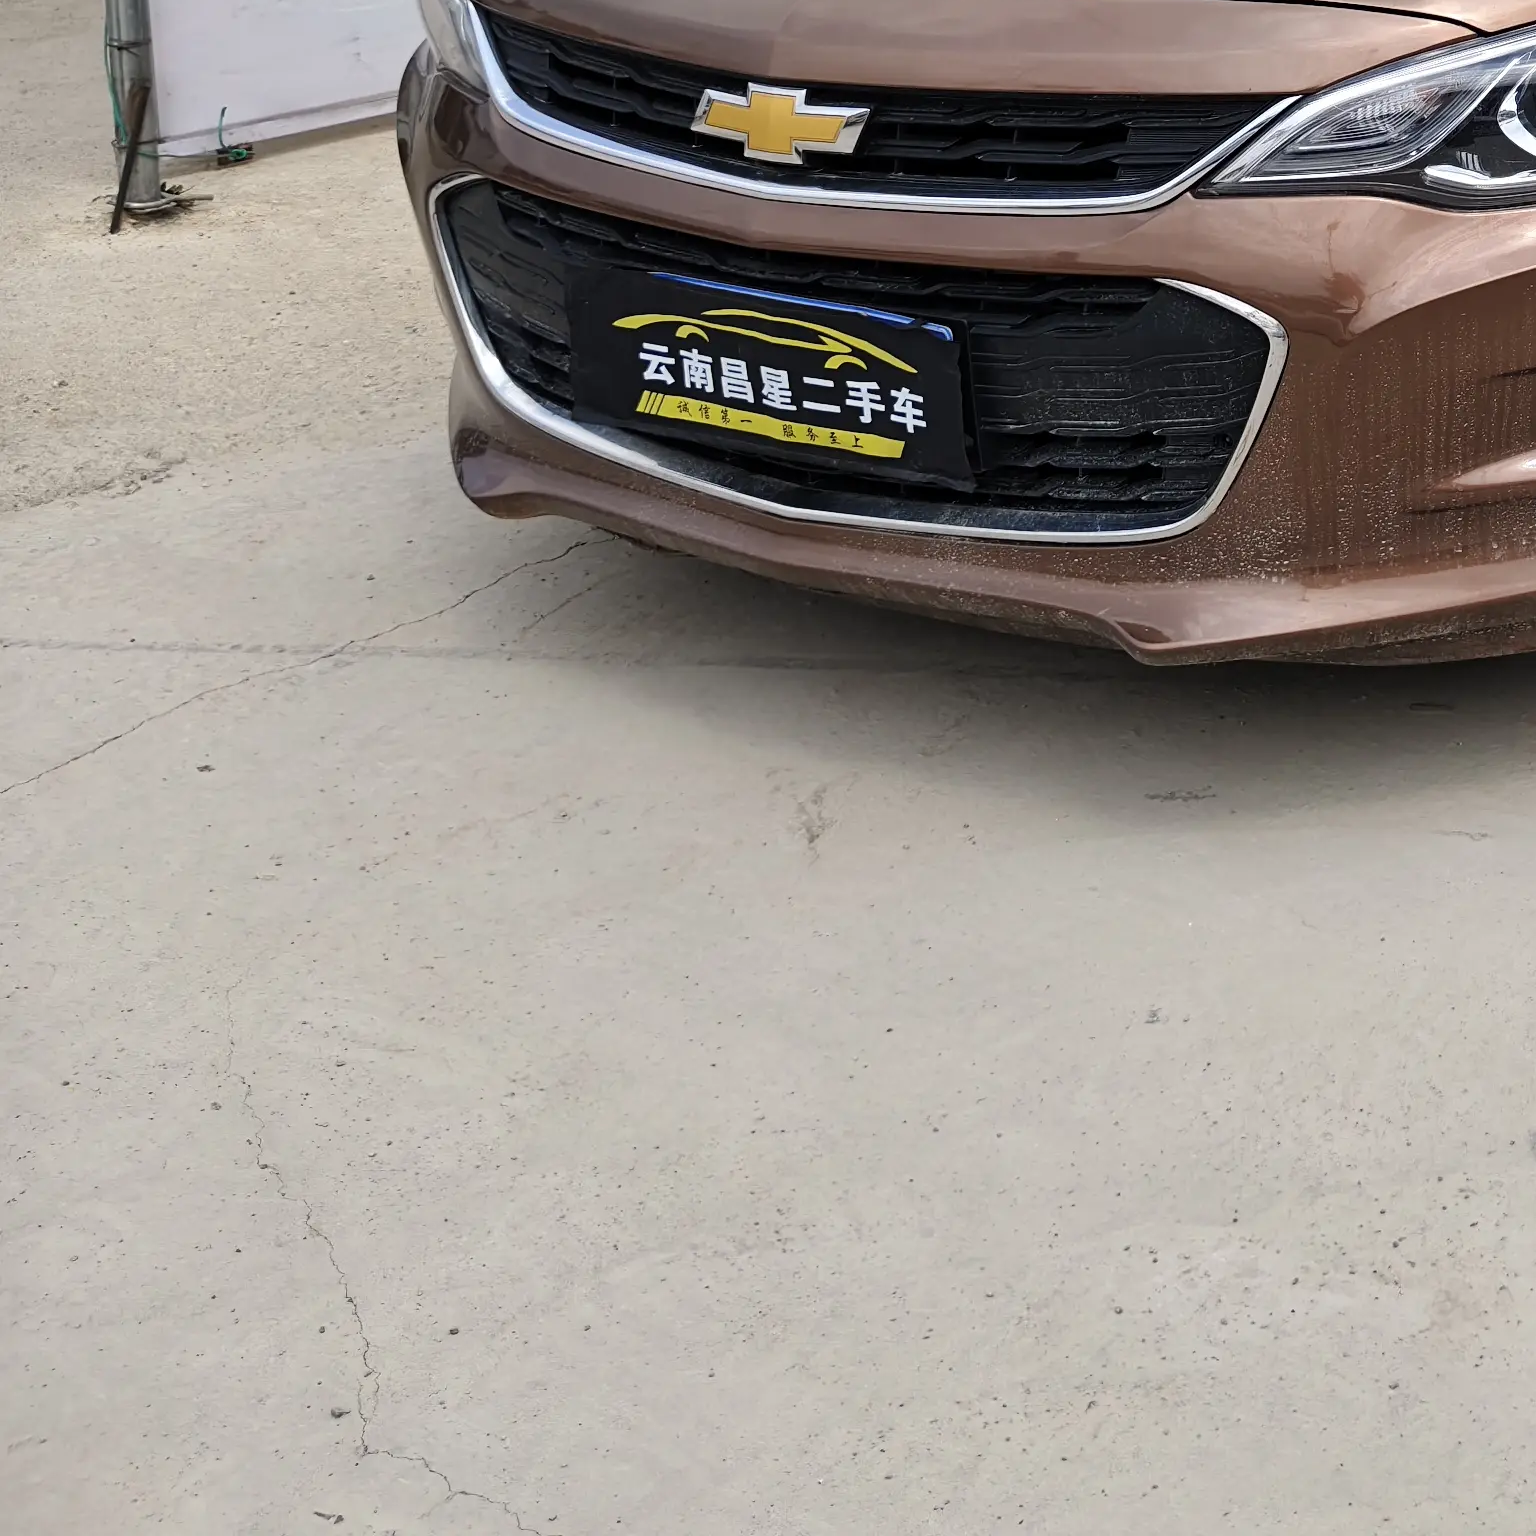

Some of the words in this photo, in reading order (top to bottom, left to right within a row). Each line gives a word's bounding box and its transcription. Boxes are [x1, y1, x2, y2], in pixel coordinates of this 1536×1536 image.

[638, 342, 927, 434] 云南昌星二手车
